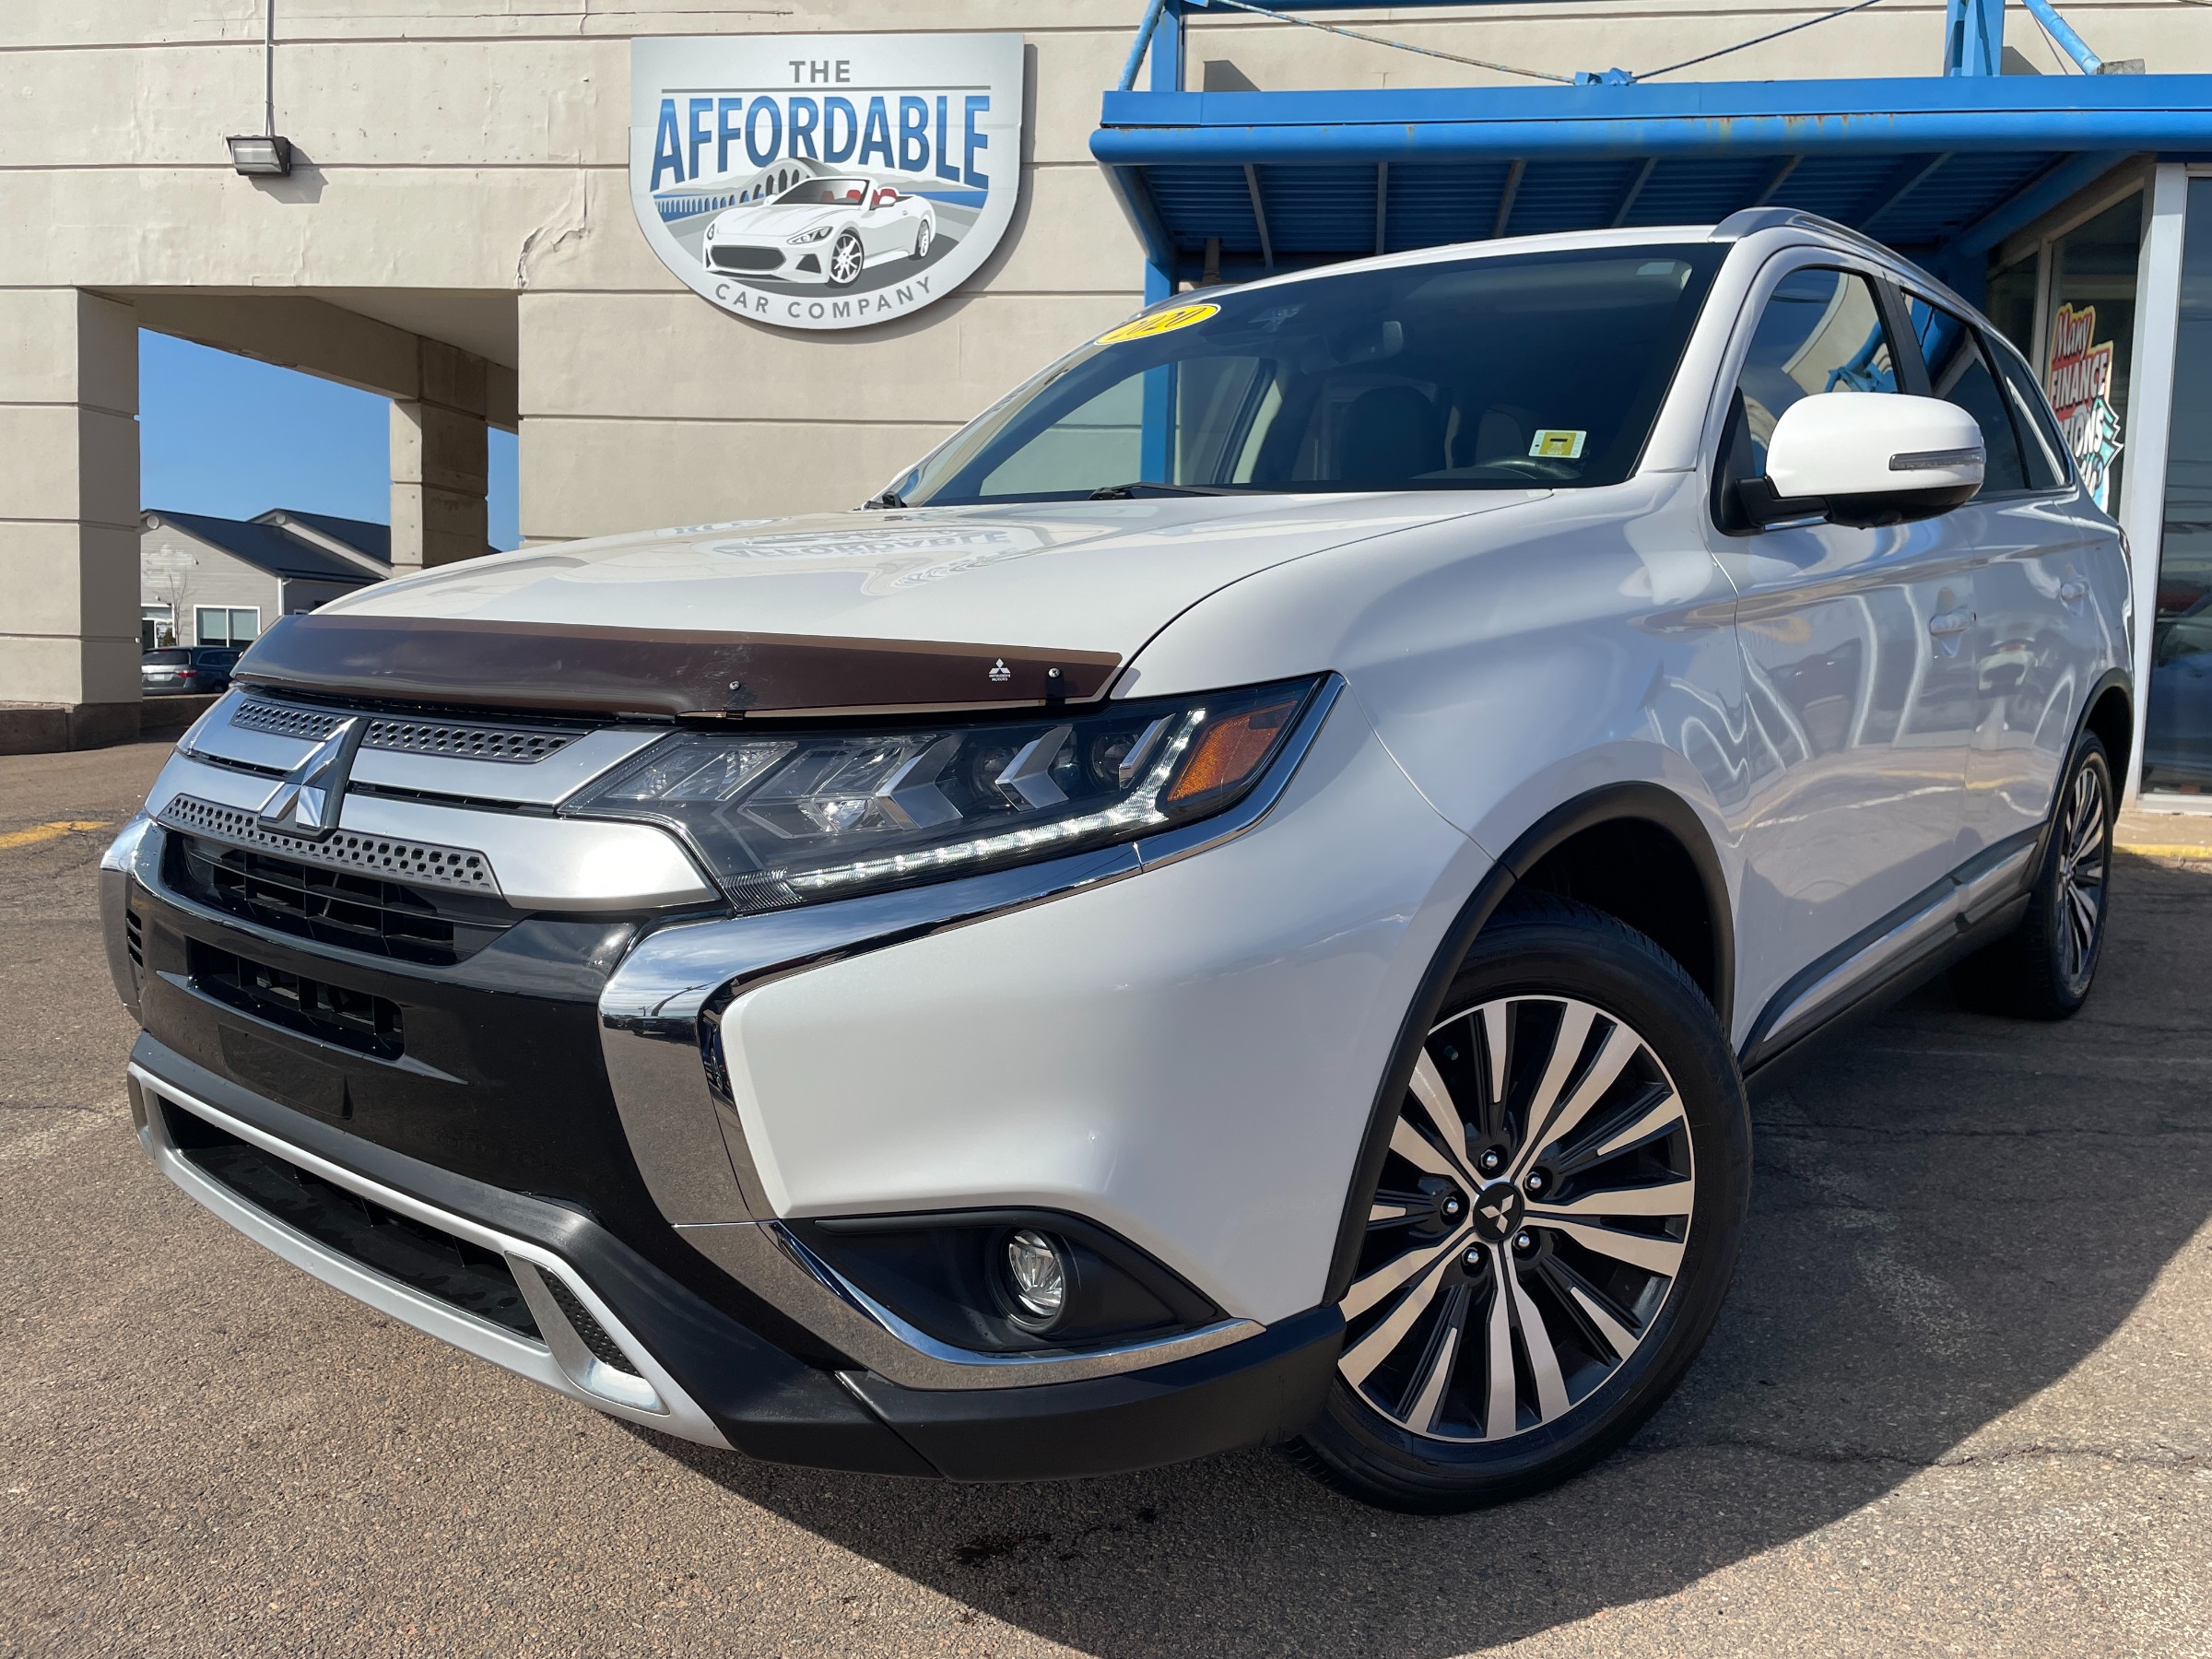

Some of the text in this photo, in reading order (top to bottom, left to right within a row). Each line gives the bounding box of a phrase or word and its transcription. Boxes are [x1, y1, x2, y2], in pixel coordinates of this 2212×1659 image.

[789, 60, 850, 84] THE
[649, 95, 991, 193] AFFORDABLE
[714, 276, 932, 320] CAR COMPANY
[2053, 312, 2091, 360] Many
[2050, 352, 2108, 408] FINANCE
